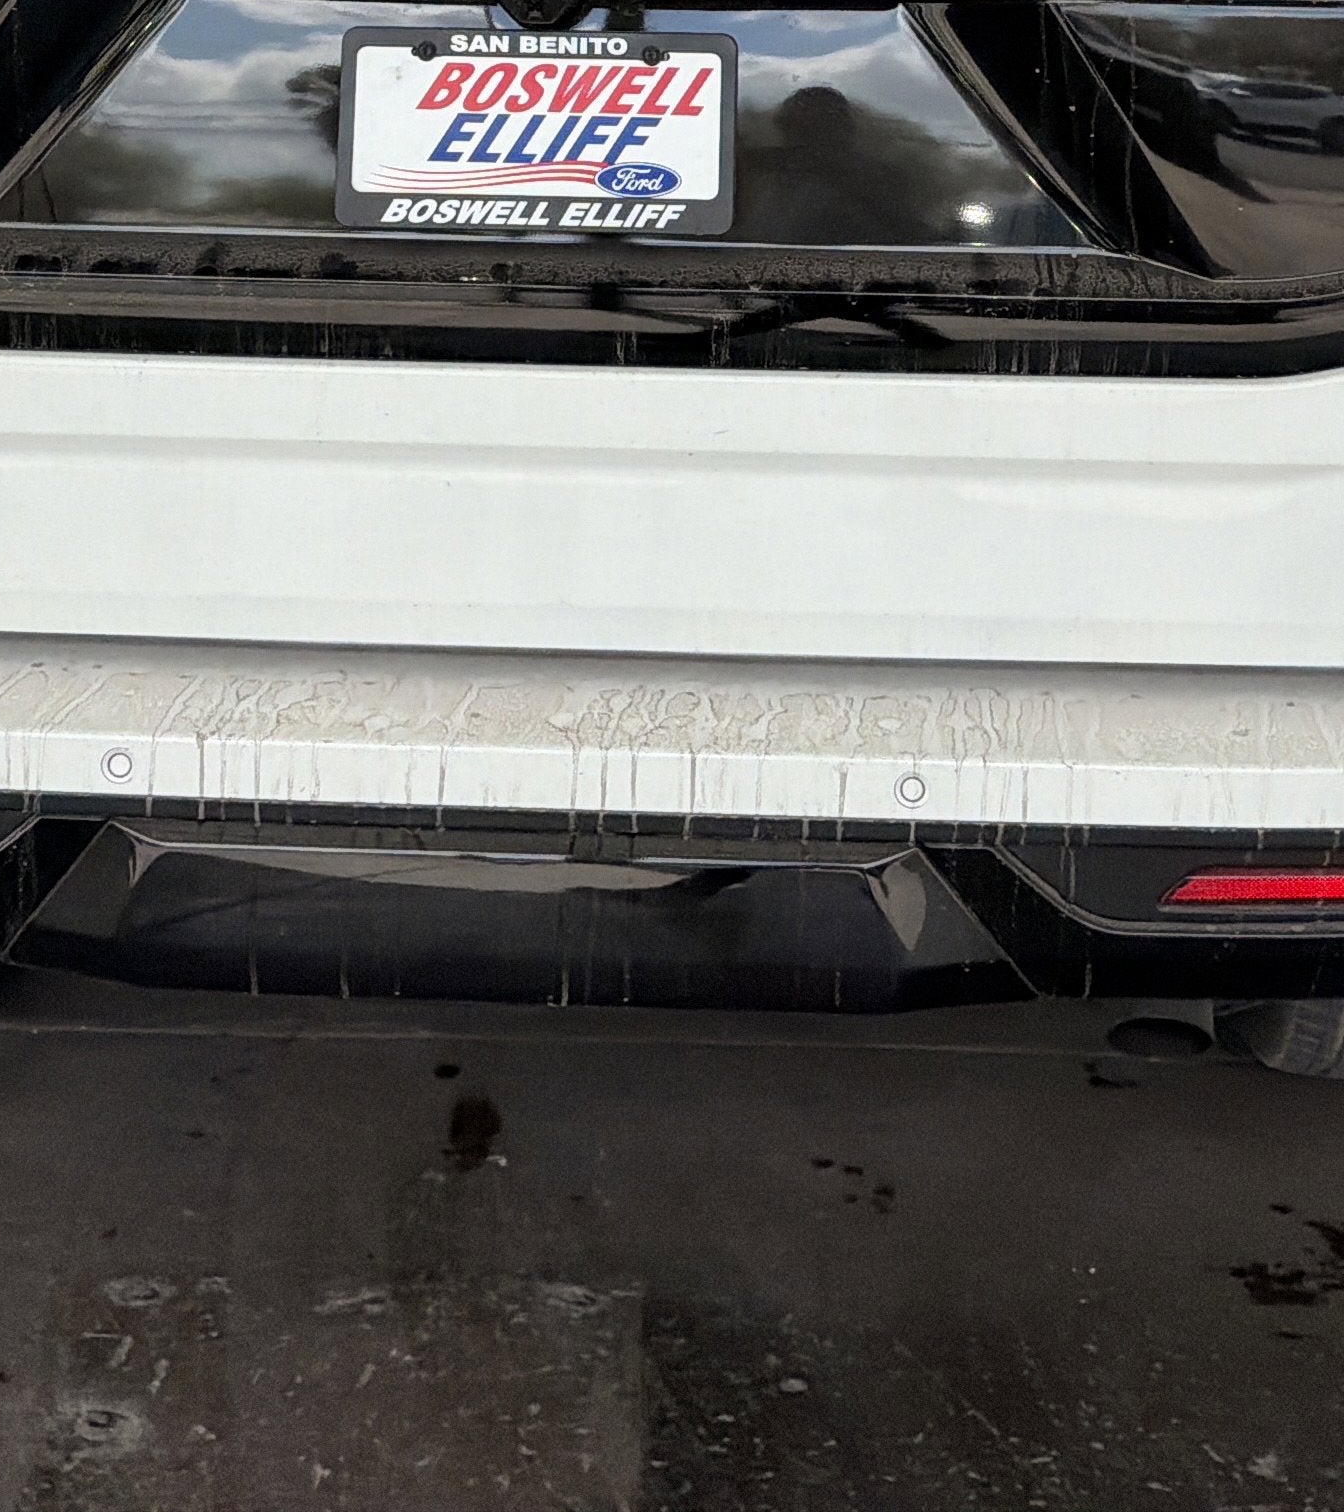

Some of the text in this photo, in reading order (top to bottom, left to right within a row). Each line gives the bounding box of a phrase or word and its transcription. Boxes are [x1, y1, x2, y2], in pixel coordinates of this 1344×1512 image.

[450, 34, 628, 56] SAN BENITO
[415, 62, 715, 117] BOSWELL
[427, 112, 662, 164] ELLIFF
[611, 168, 663, 192] Ford
[381, 198, 686, 228] BOSWELL ELLIFF
